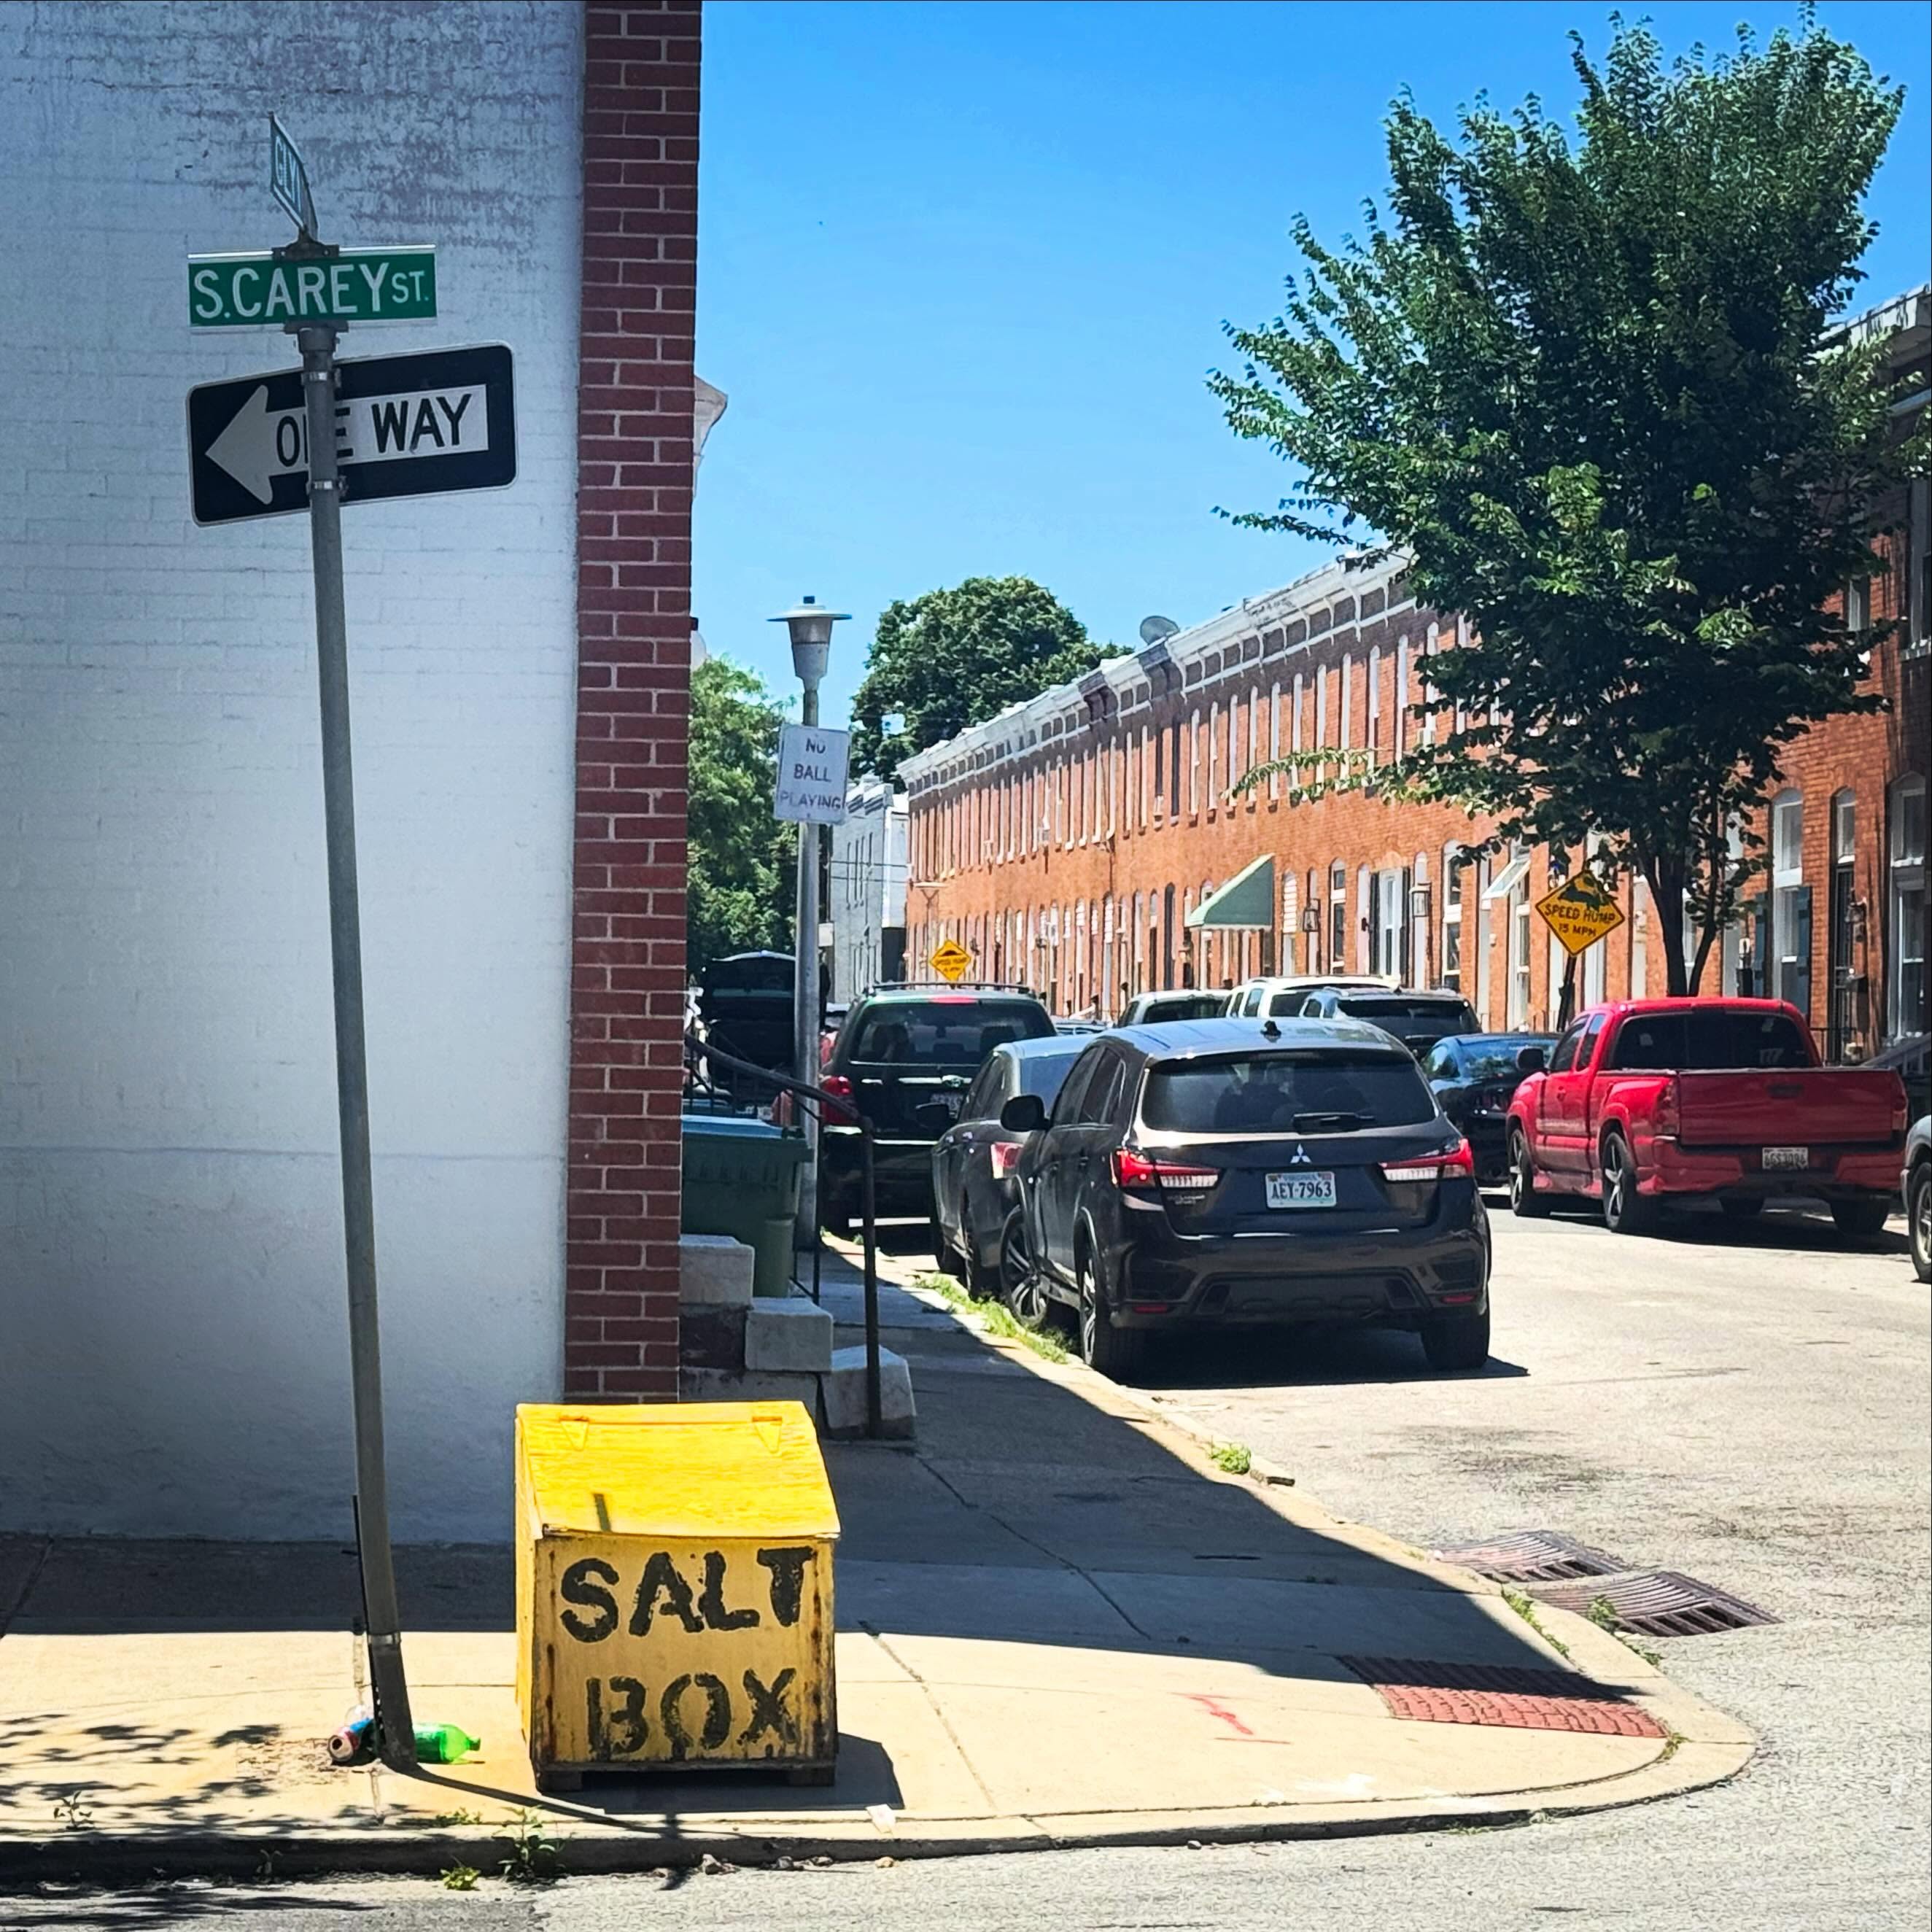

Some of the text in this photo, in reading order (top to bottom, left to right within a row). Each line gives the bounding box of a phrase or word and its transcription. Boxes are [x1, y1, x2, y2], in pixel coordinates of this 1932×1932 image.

[392, 270, 430, 303] ST.
[276, 393, 472, 467] OE WAY
[805, 737, 826, 754] NO
[793, 764, 832, 783] BALL
[780, 790, 842, 812] PLAYING
[1544, 904, 1580, 920] SPEED
[1559, 923, 1597, 937] 15 MPH
[559, 1545, 818, 1643] SALT
[586, 1667, 797, 1755] BOX
